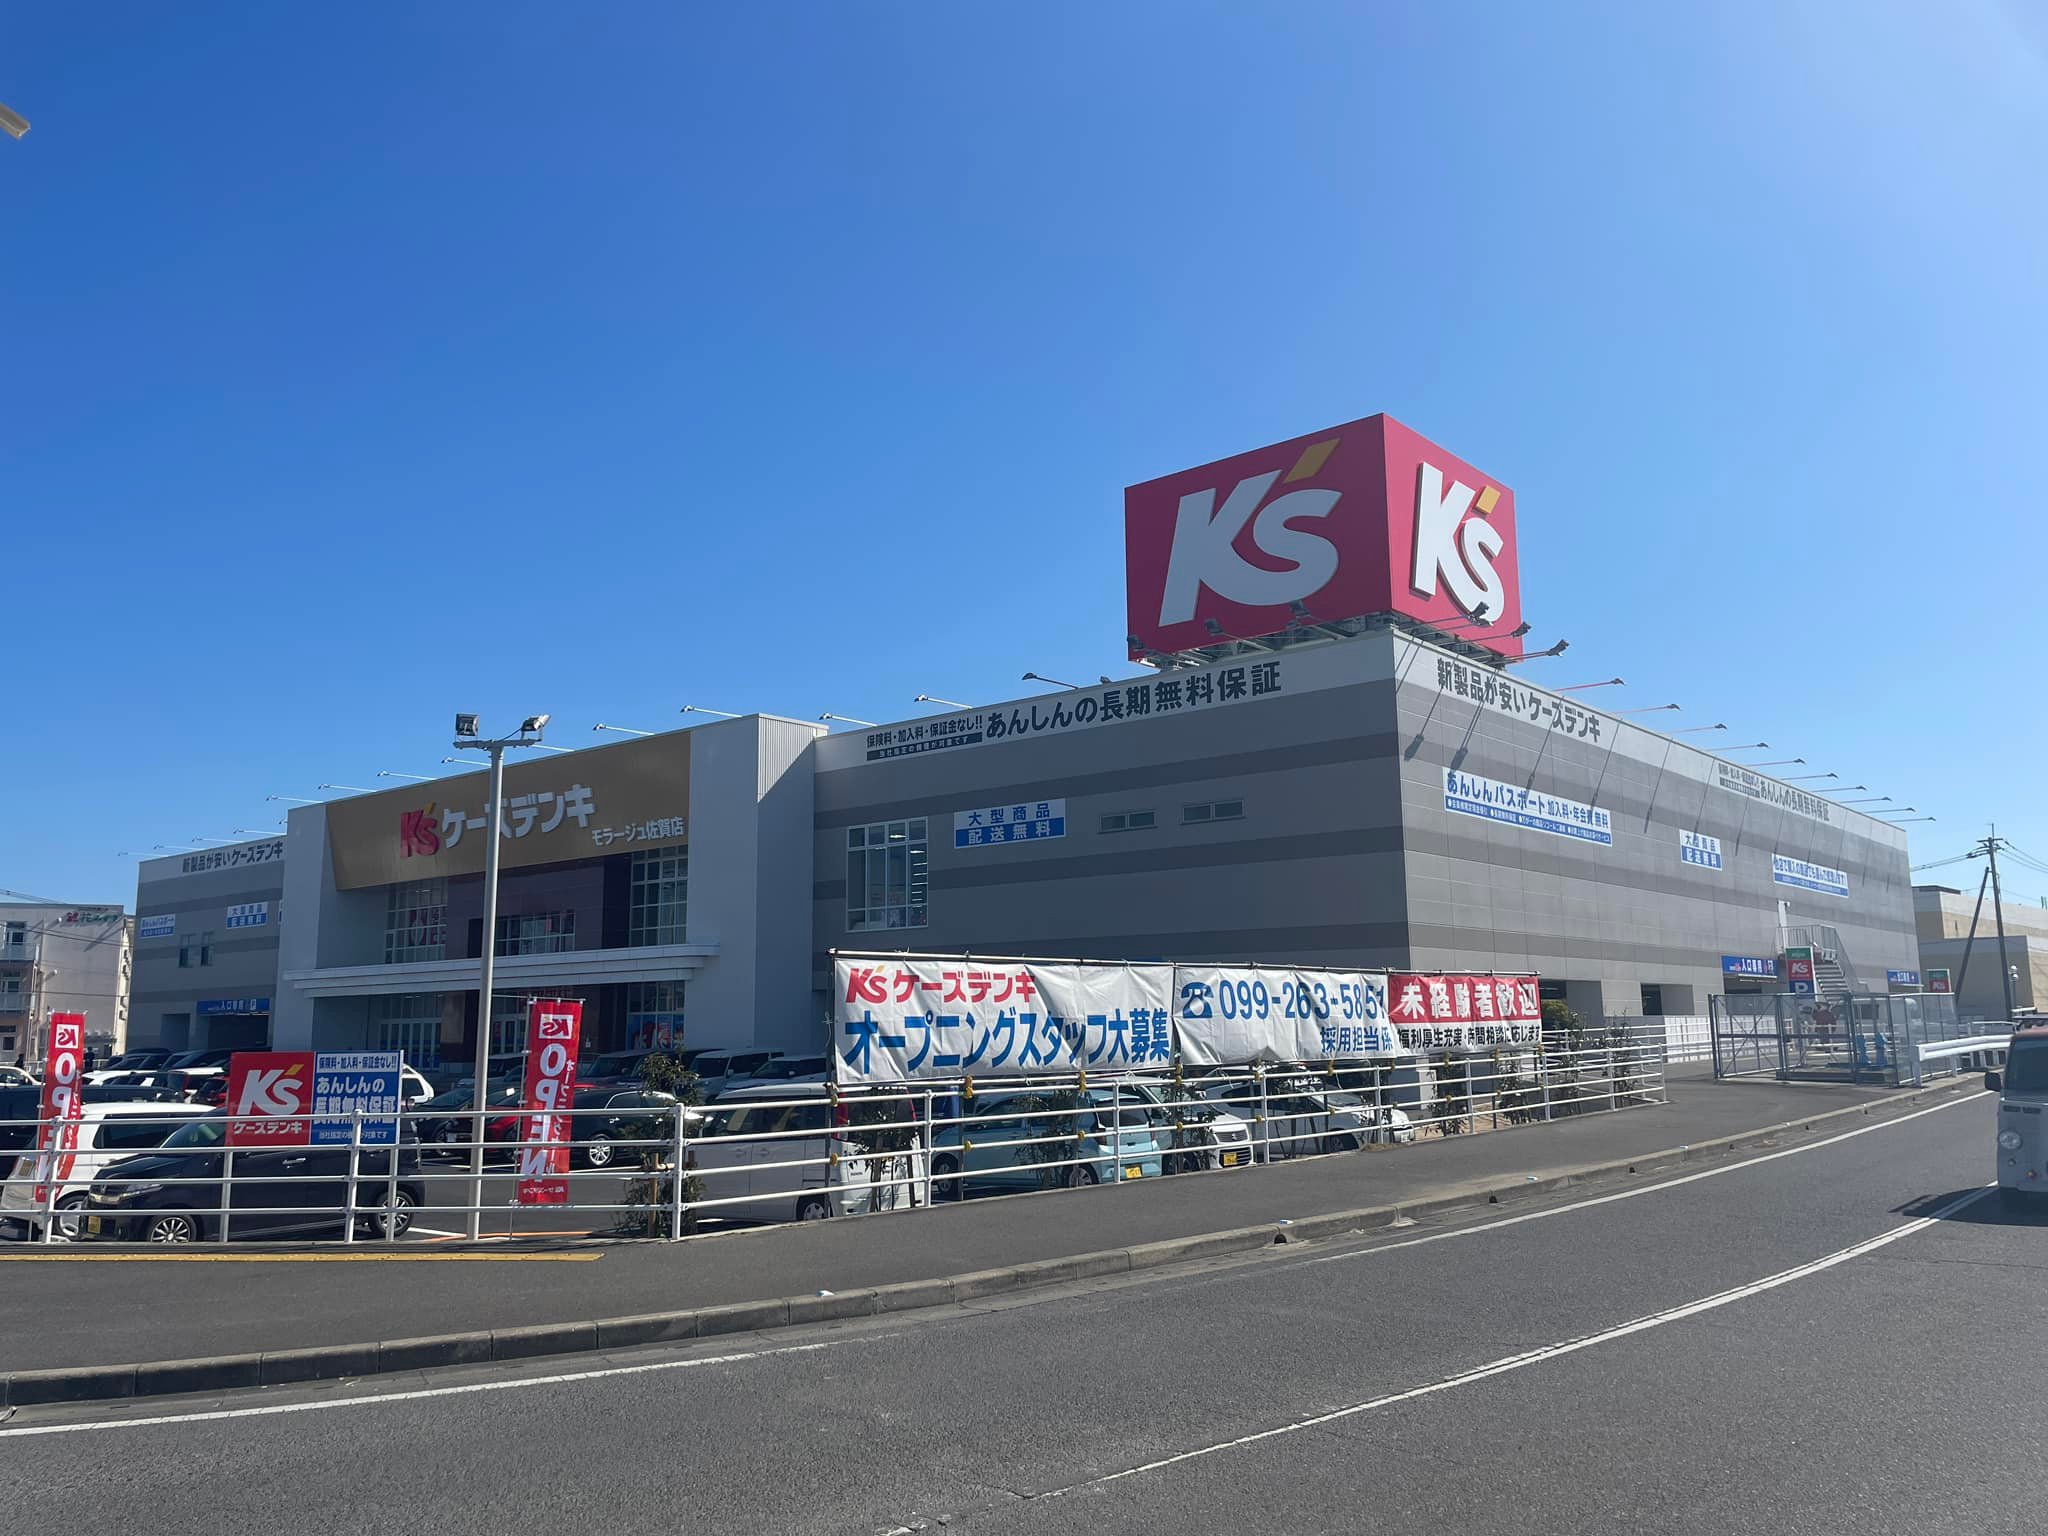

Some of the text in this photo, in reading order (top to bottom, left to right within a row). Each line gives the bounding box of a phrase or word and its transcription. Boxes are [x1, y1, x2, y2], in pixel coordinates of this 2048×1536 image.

[1158, 438, 1344, 627] K's
[1413, 461, 1505, 626] K's
[986, 661, 1281, 738] あんしんの長期無料保証
[1437, 656, 1601, 743] 新製品が安いケーズデンキ
[592, 816, 684, 846] モラージュ佐賀店
[968, 803, 1051, 827] 大型商品
[968, 821, 1051, 845] 配送無料
[182, 840, 283, 873] 新製品が安いケーズデンキ
[845, 964, 1037, 1004] K's ケーズデンキ
[1219, 979, 1385, 1020] 099-263-5851
[1400, 982, 1539, 1019] 未経験者歓迎
[843, 1007, 1170, 1075] オープニングスタッフ大募集
[1320, 1026, 1393, 1053] 採用担当係
[236, 1064, 304, 1116] K's
[316, 1075, 385, 1095] あんしんの
[233, 1121, 302, 1135] ケーズデンキ
